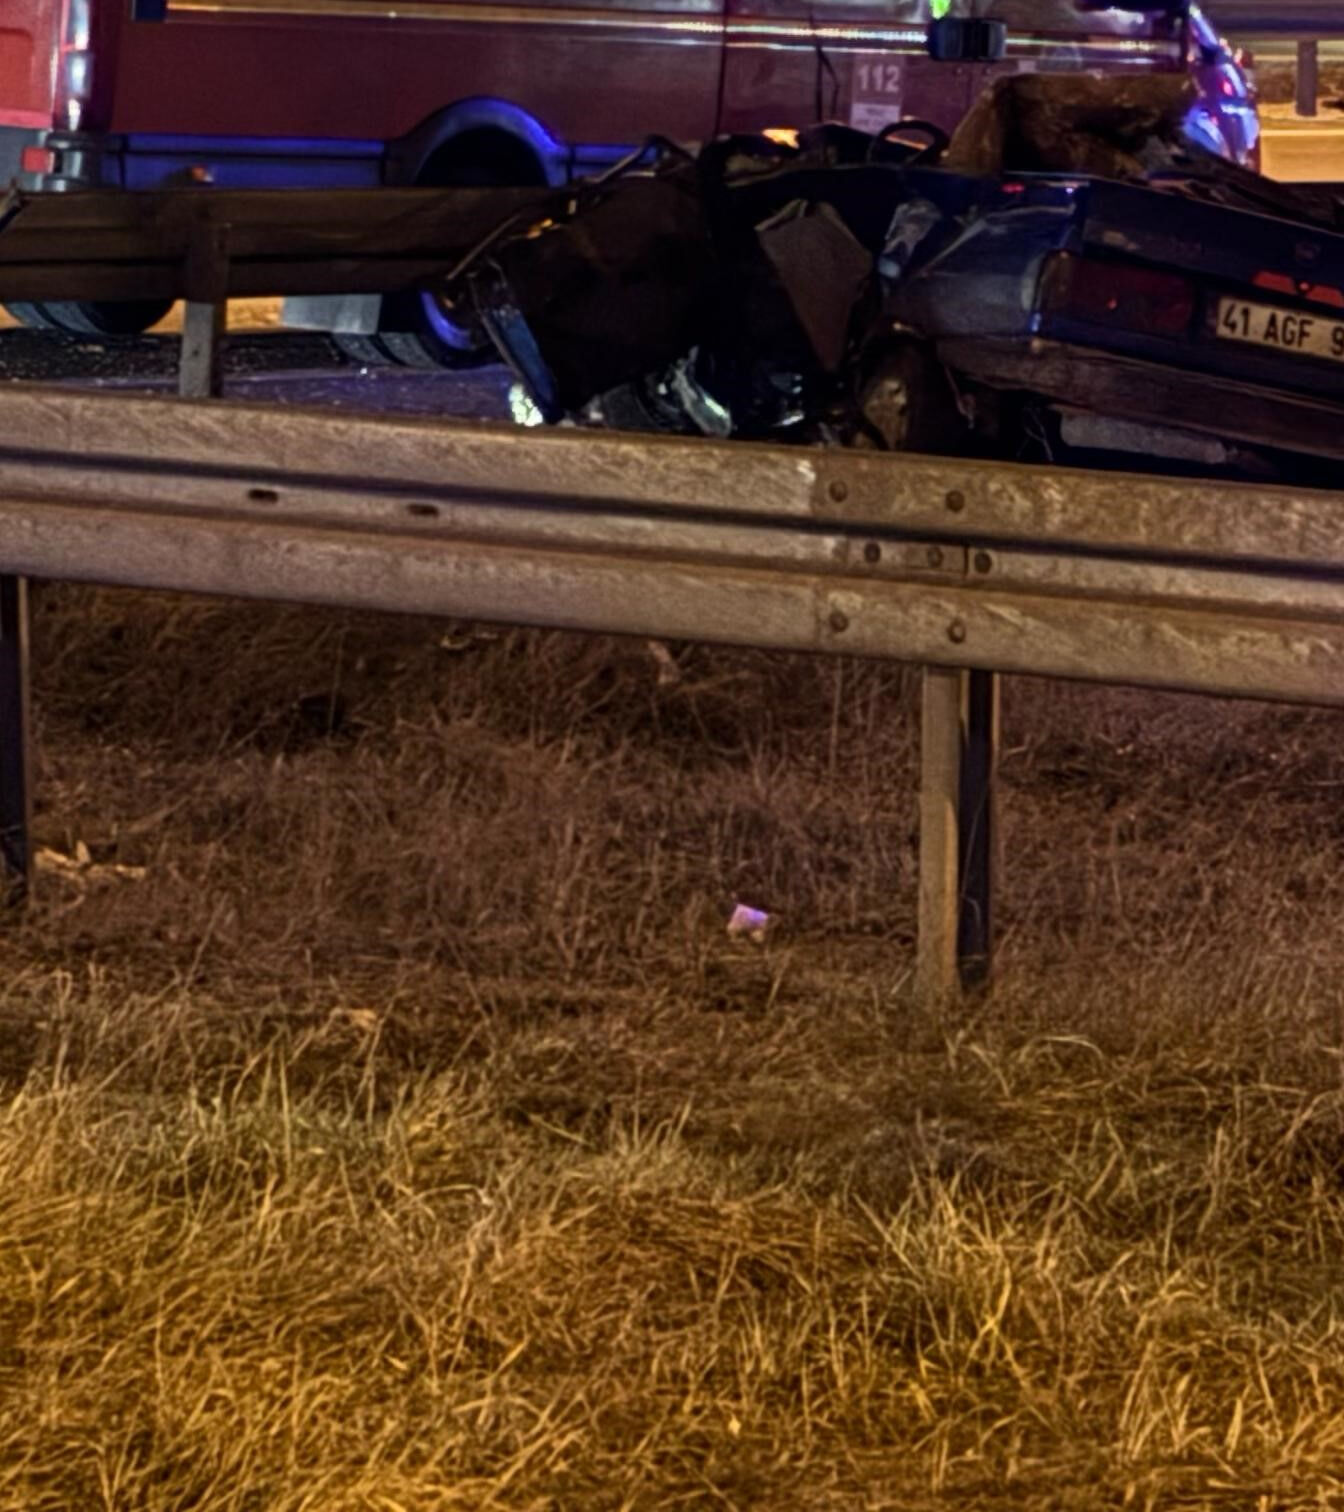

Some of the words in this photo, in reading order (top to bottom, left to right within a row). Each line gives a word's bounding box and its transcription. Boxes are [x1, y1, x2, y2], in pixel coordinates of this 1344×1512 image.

[858, 65, 900, 92] 112
[1222, 303, 1250, 336] 41
[1263, 311, 1314, 349] AGF
